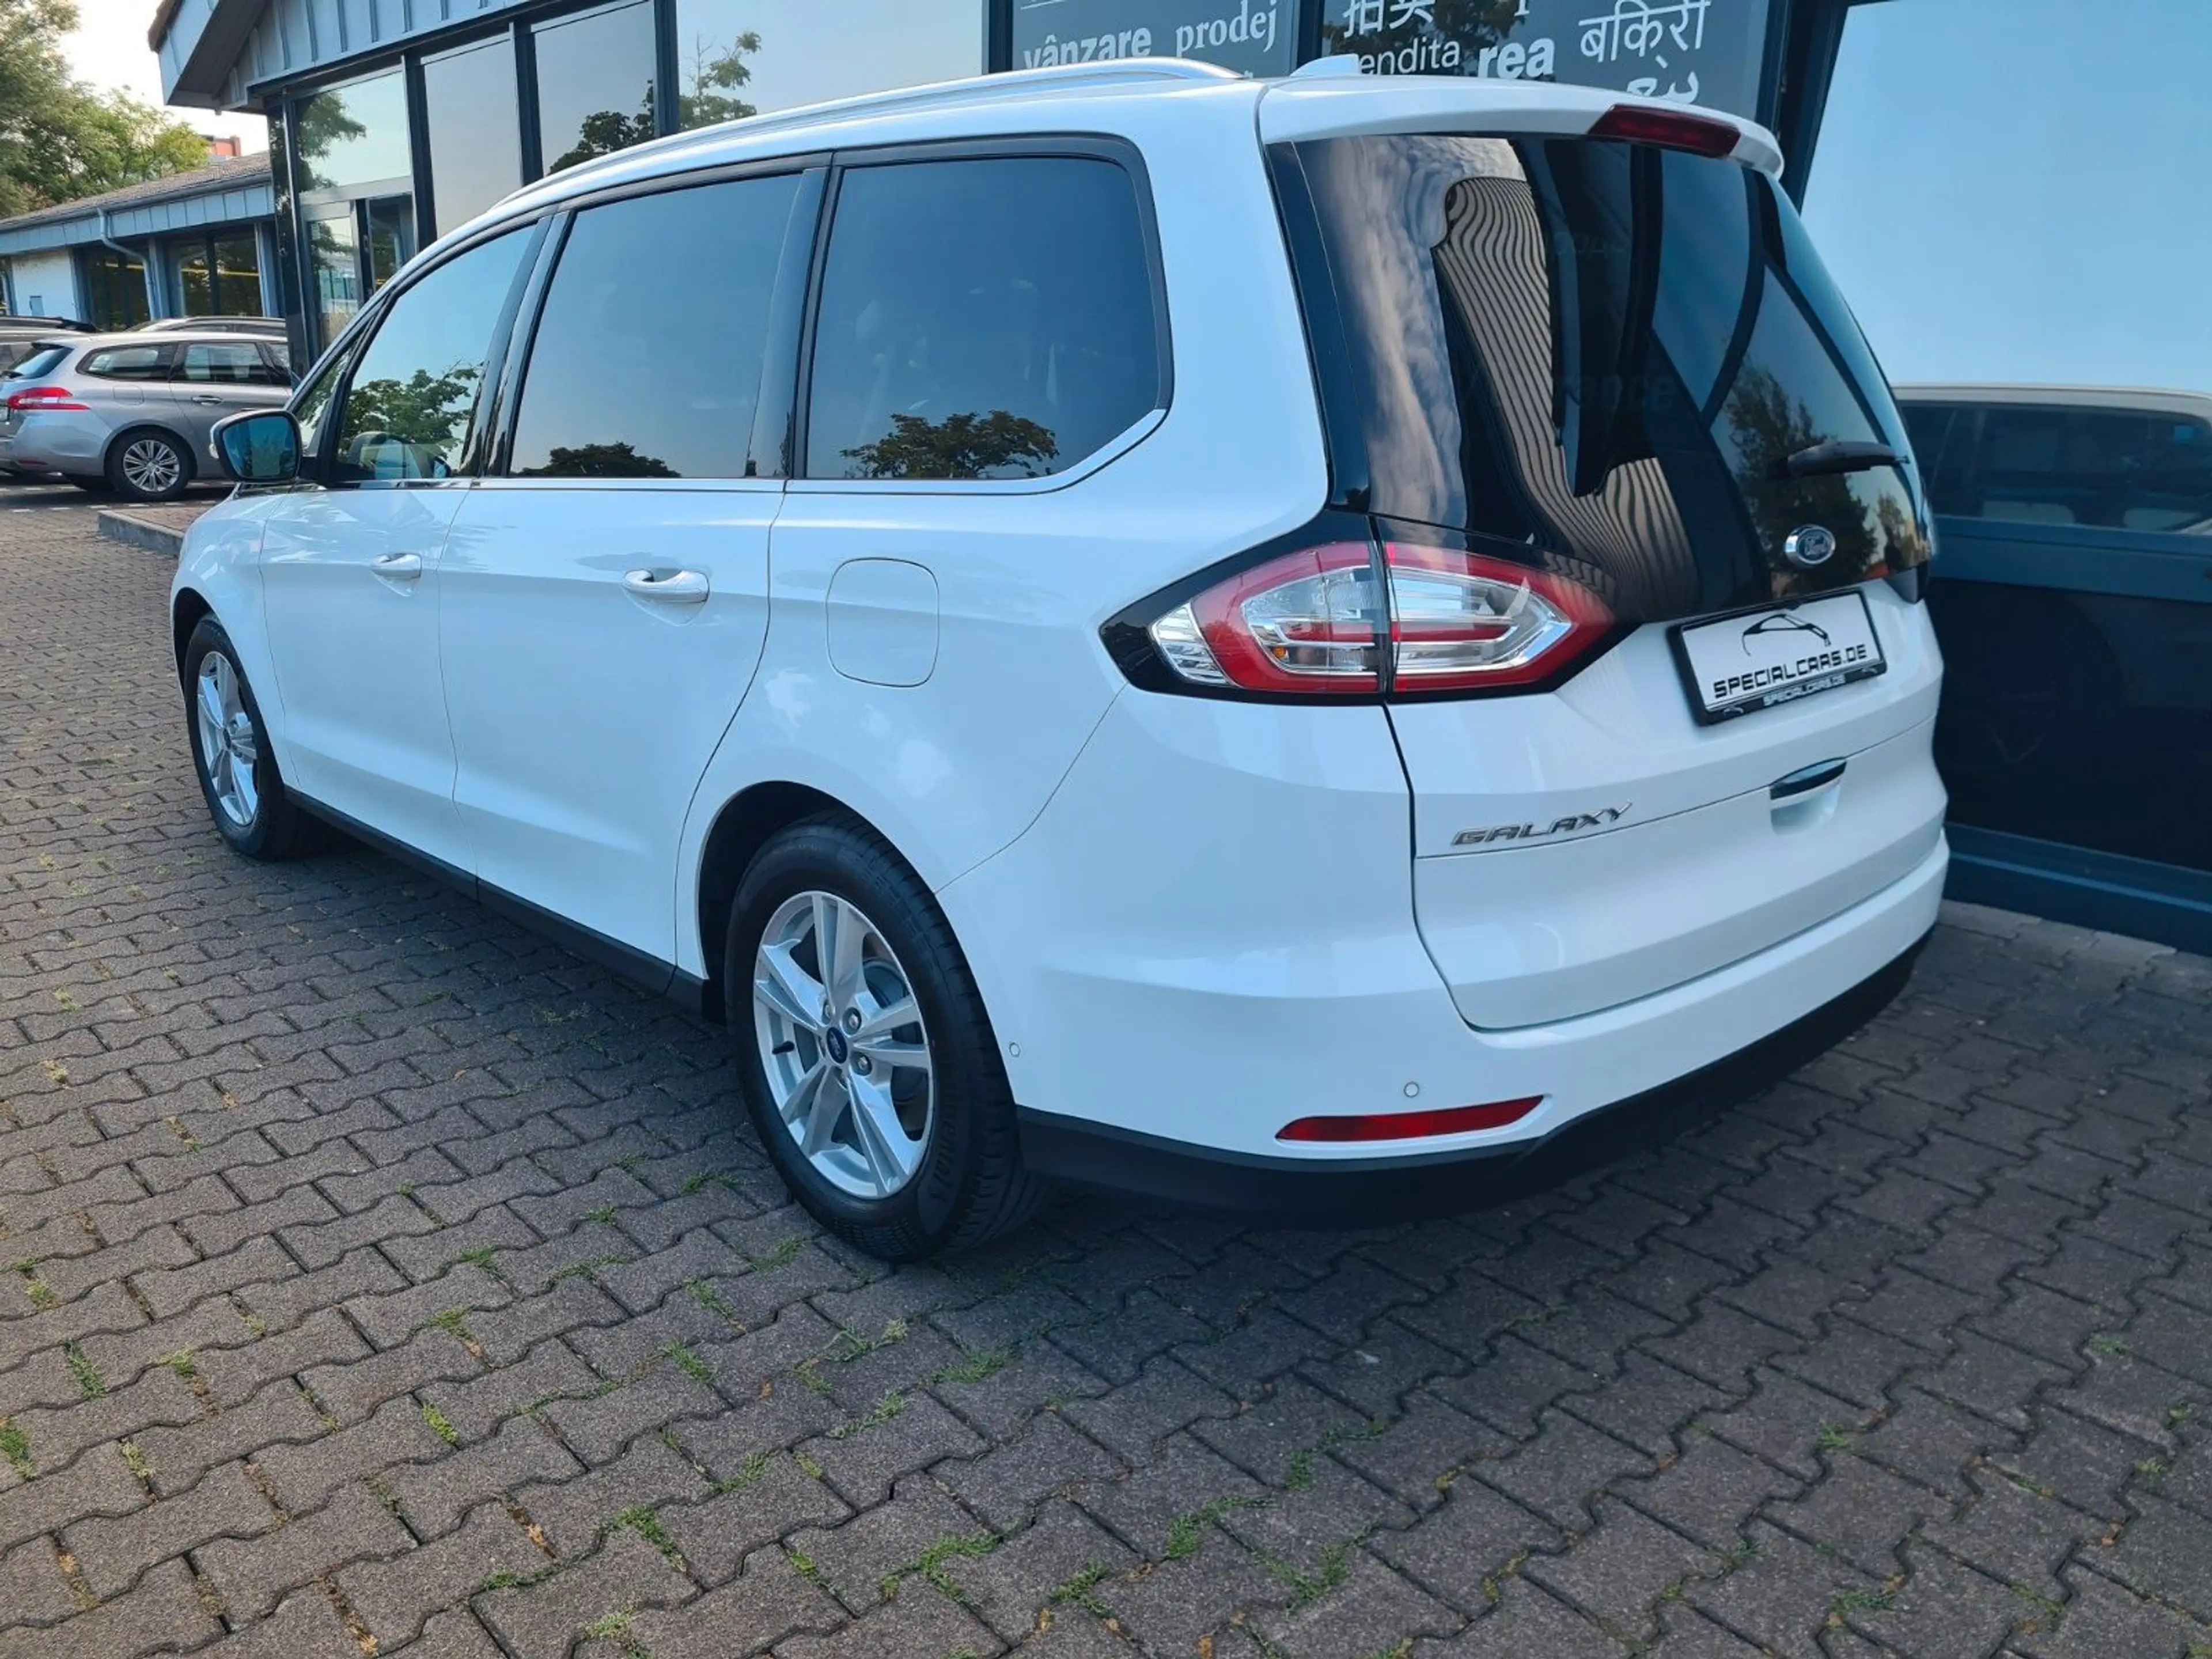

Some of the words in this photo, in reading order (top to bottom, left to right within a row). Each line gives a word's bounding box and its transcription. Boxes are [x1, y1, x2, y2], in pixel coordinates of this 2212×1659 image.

[1022, 27, 1152, 69] vânzare
[1175, 0, 1276, 56] prodej
[1359, 36, 1460, 75] endita
[1477, 37, 1555, 80] rea
[1713, 643, 1868, 699] SPECIALCARS.DE
[1451, 797, 1635, 846] GALAXY
